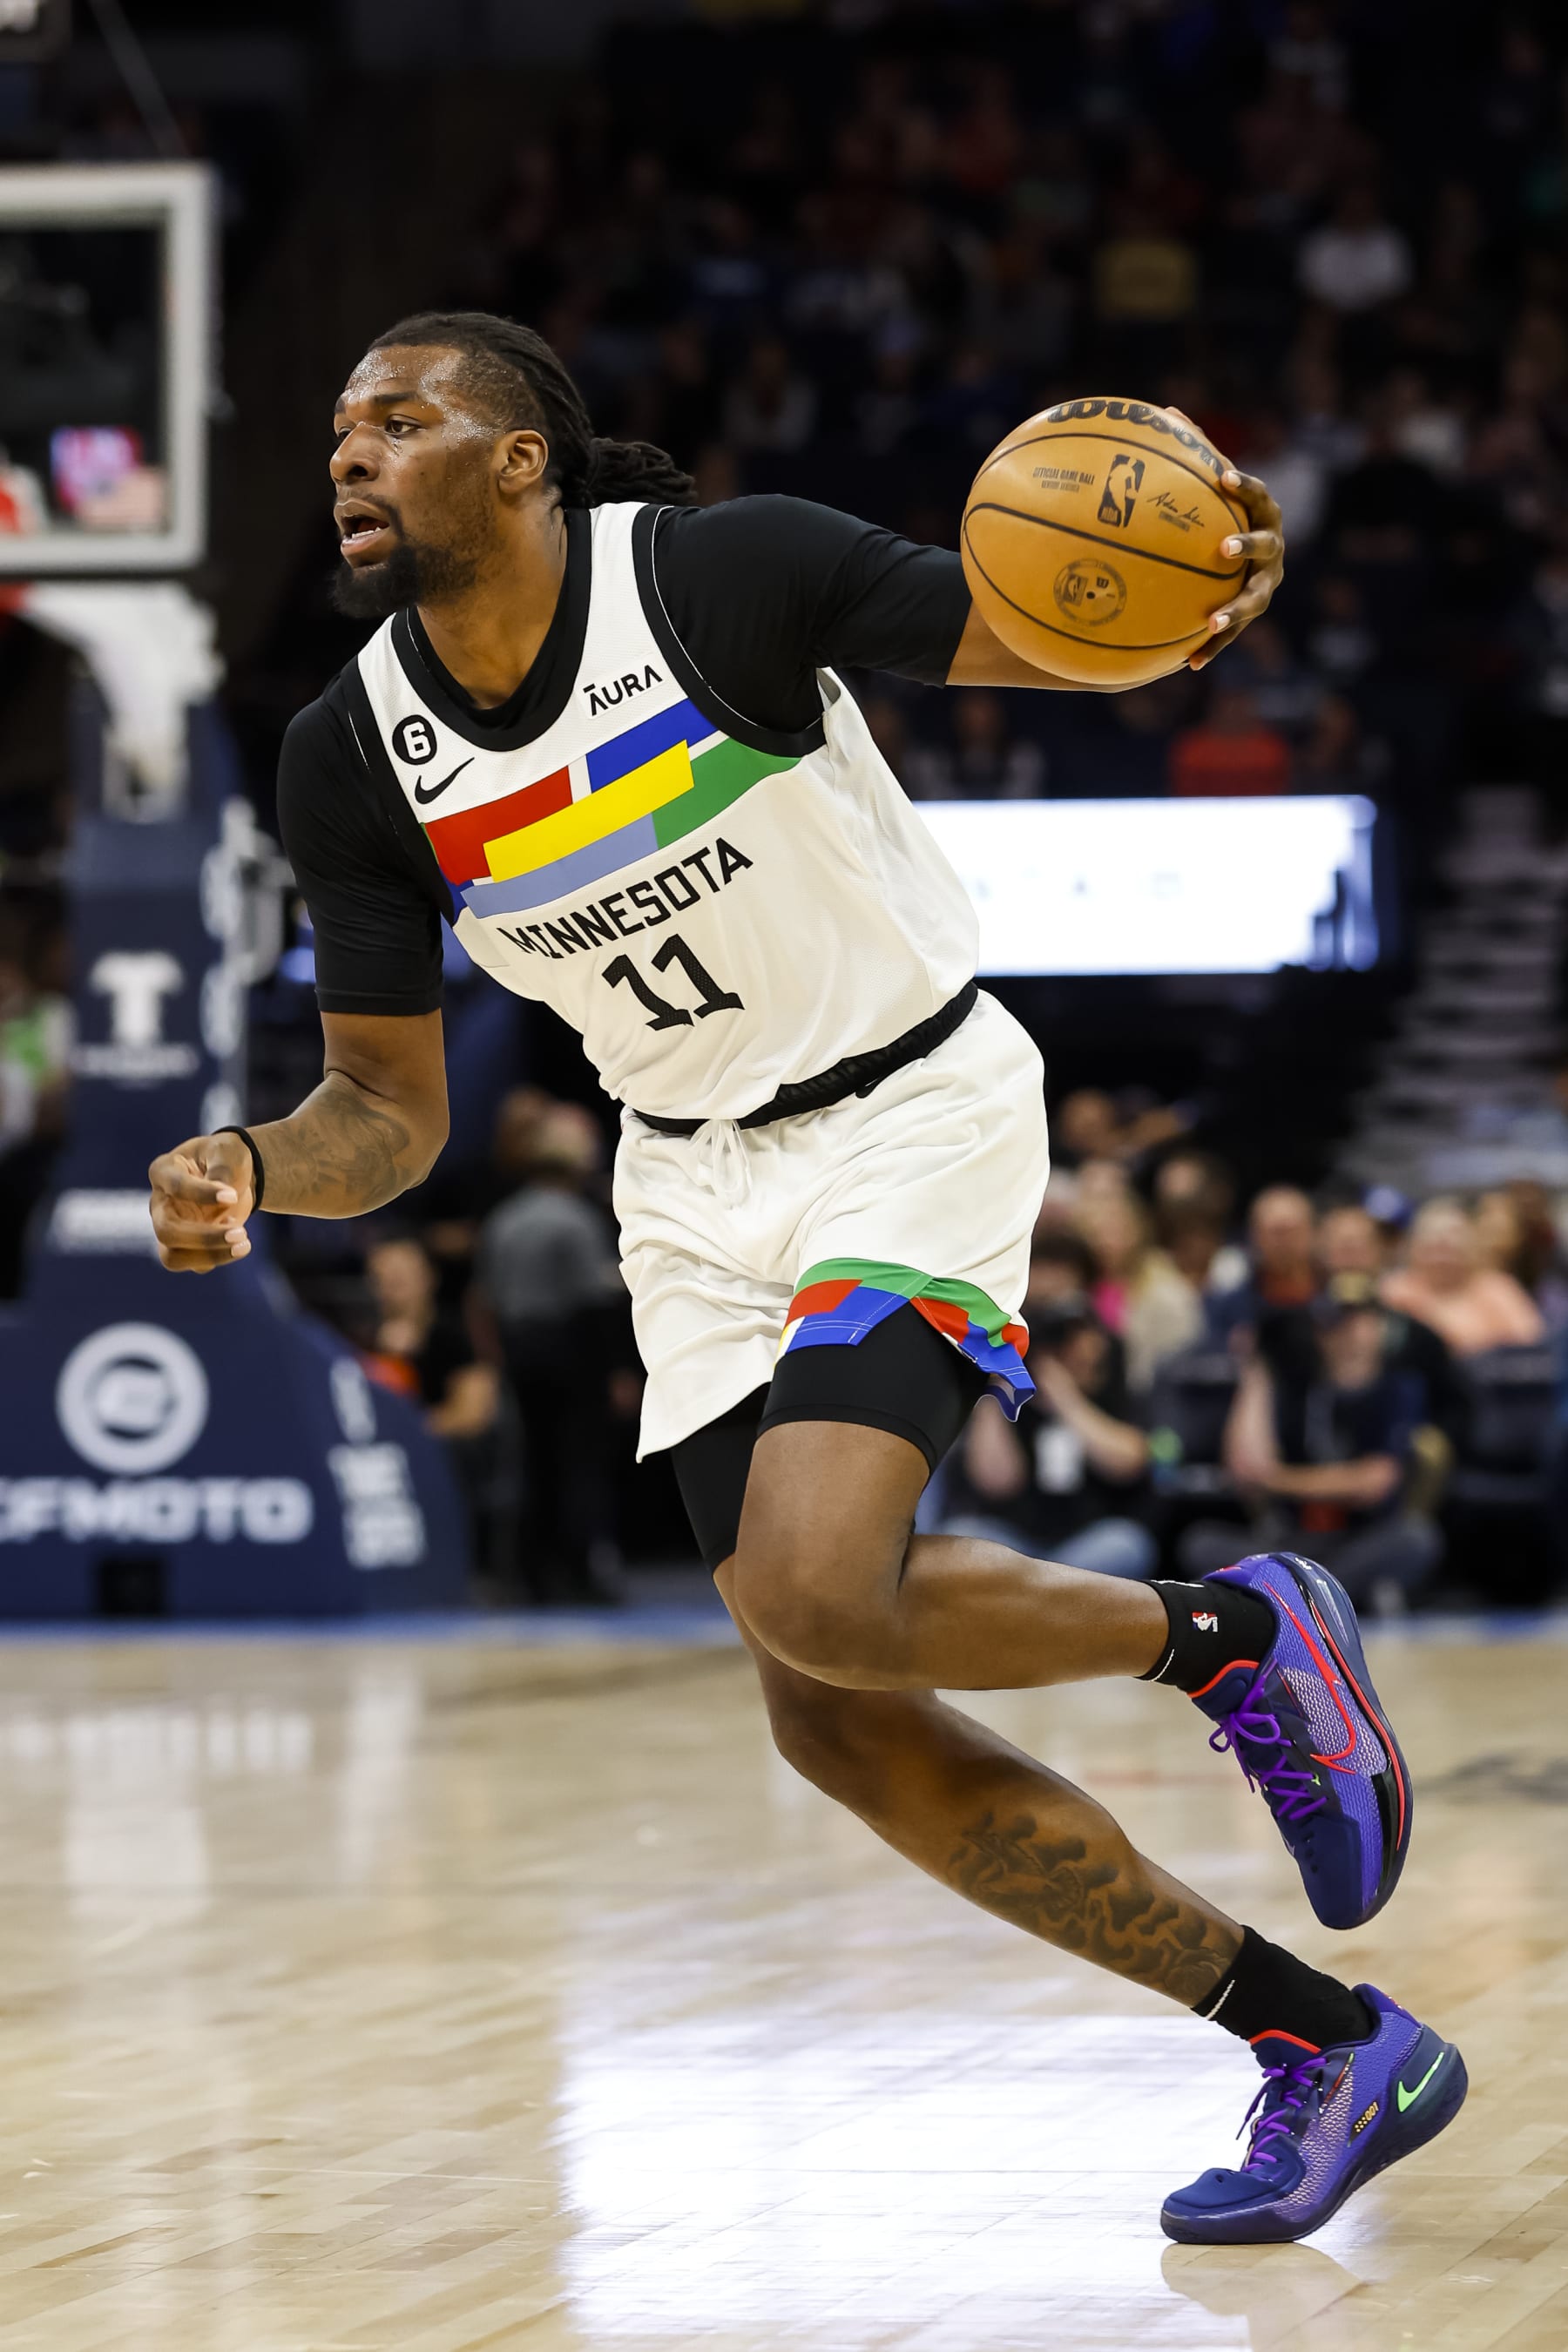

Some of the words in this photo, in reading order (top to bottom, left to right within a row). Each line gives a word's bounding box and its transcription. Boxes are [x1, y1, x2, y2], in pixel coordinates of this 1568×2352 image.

[402, 720, 432, 760] 6
[497, 837, 754, 959] MINNESOTA
[602, 934, 745, 1031] 11
